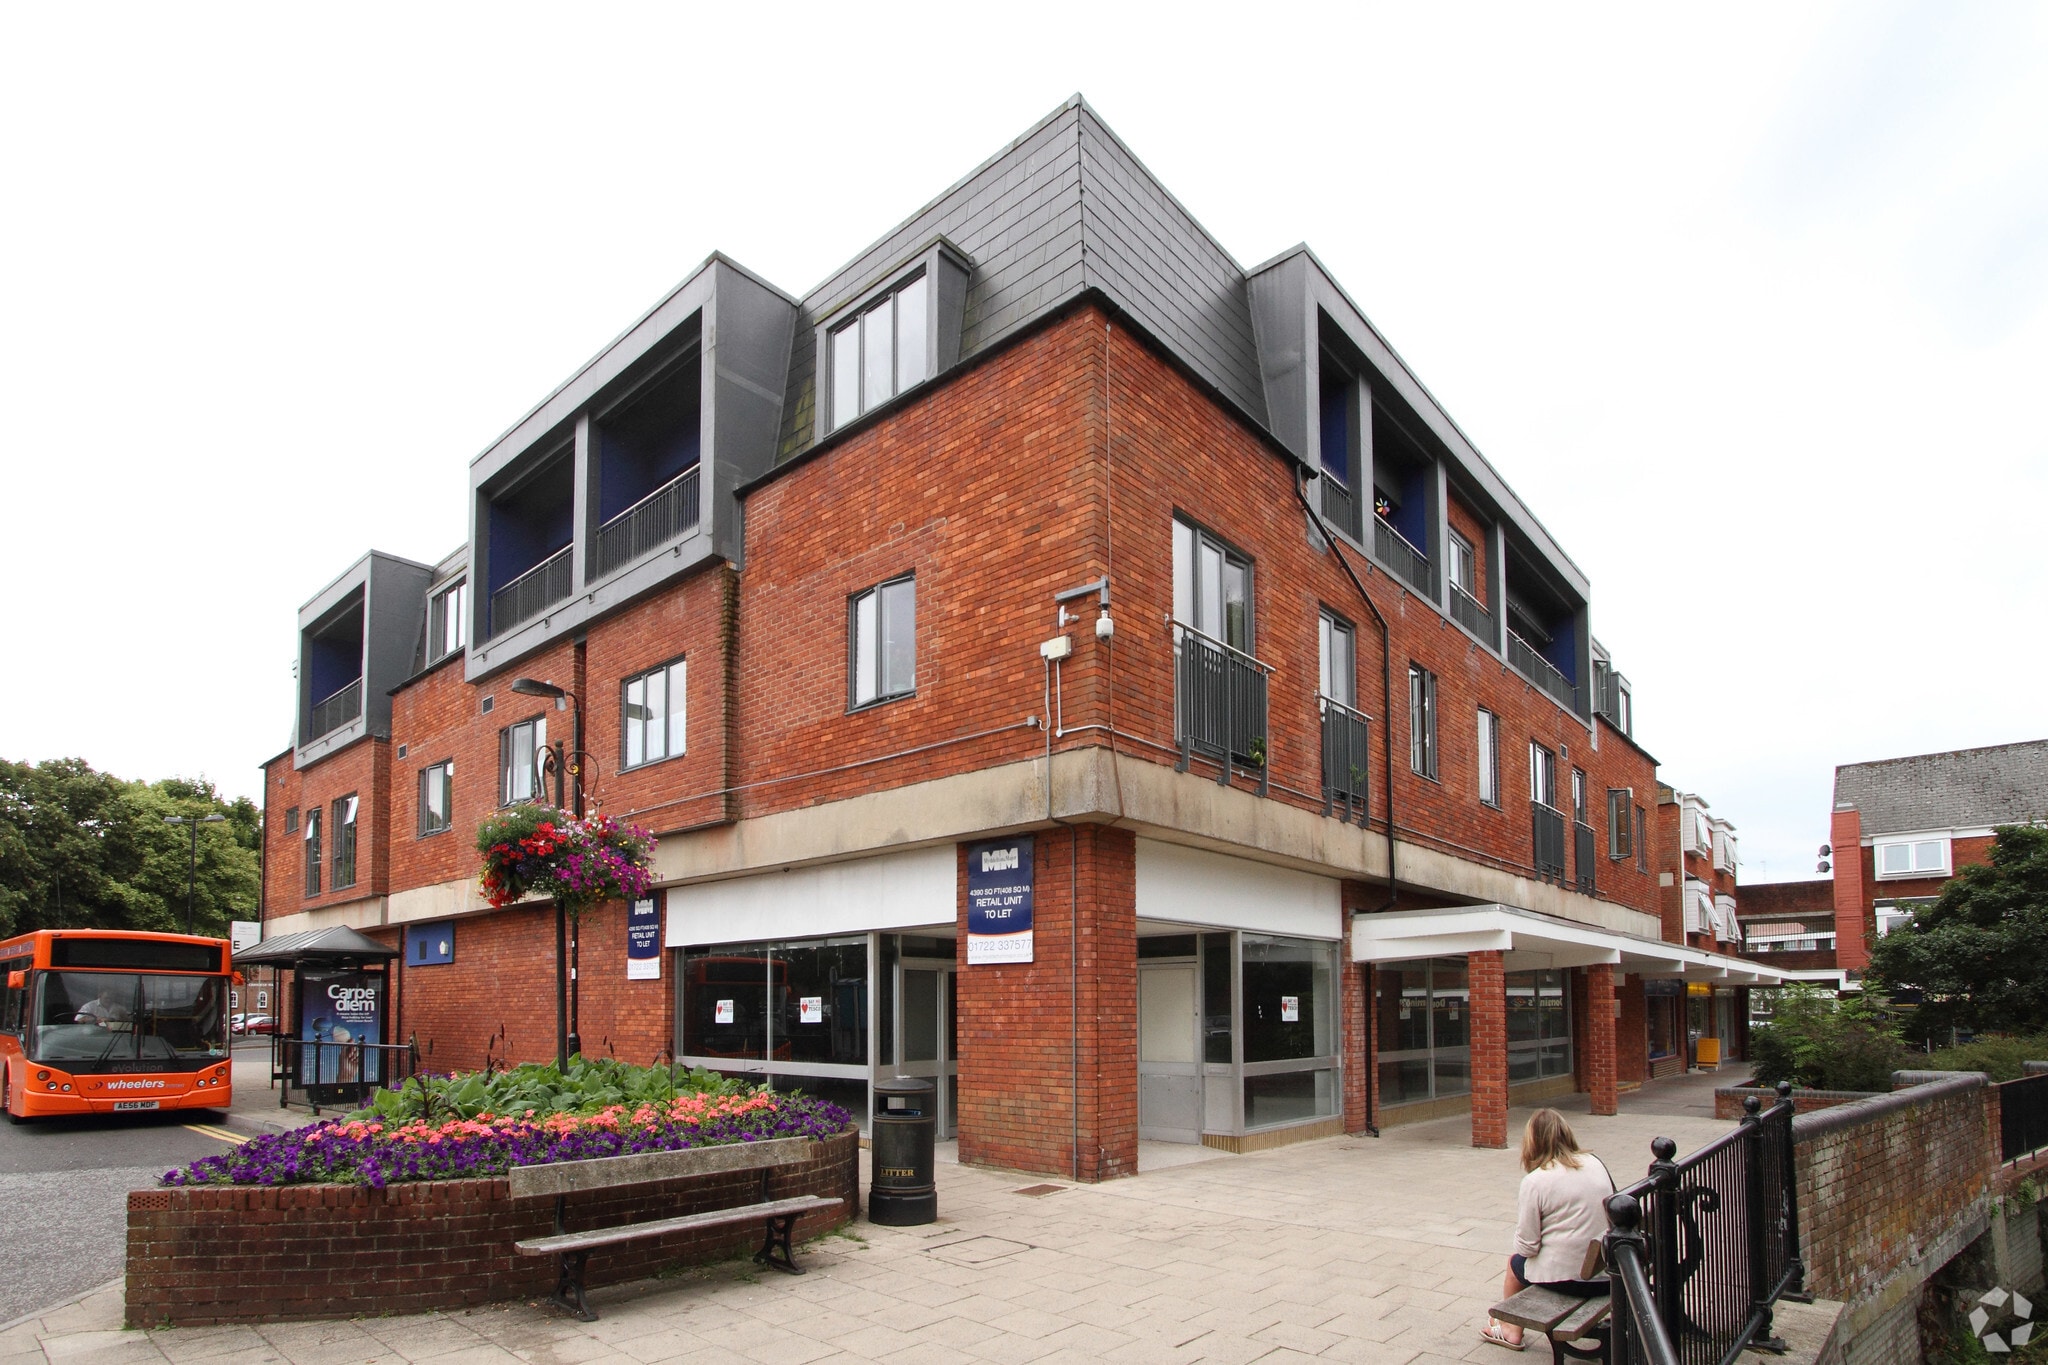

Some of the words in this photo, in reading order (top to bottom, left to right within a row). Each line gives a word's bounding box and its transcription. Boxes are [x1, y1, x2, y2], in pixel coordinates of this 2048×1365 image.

[976, 898, 1002, 907] RETAIL
[1004, 896, 1022, 905] UNIT
[985, 910, 996, 919] TO
[997, 909, 1012, 918] LET
[233, 940, 240, 949] E
[969, 940, 995, 951] 01722
[998, 938, 1032, 950] 337577
[327, 984, 375, 1003] Carpe
[335, 999, 375, 1011] diem
[107, 1079, 166, 1089] wheelers
[117, 1102, 139, 1110] AE56
[881, 1169, 914, 1177] LITTER
